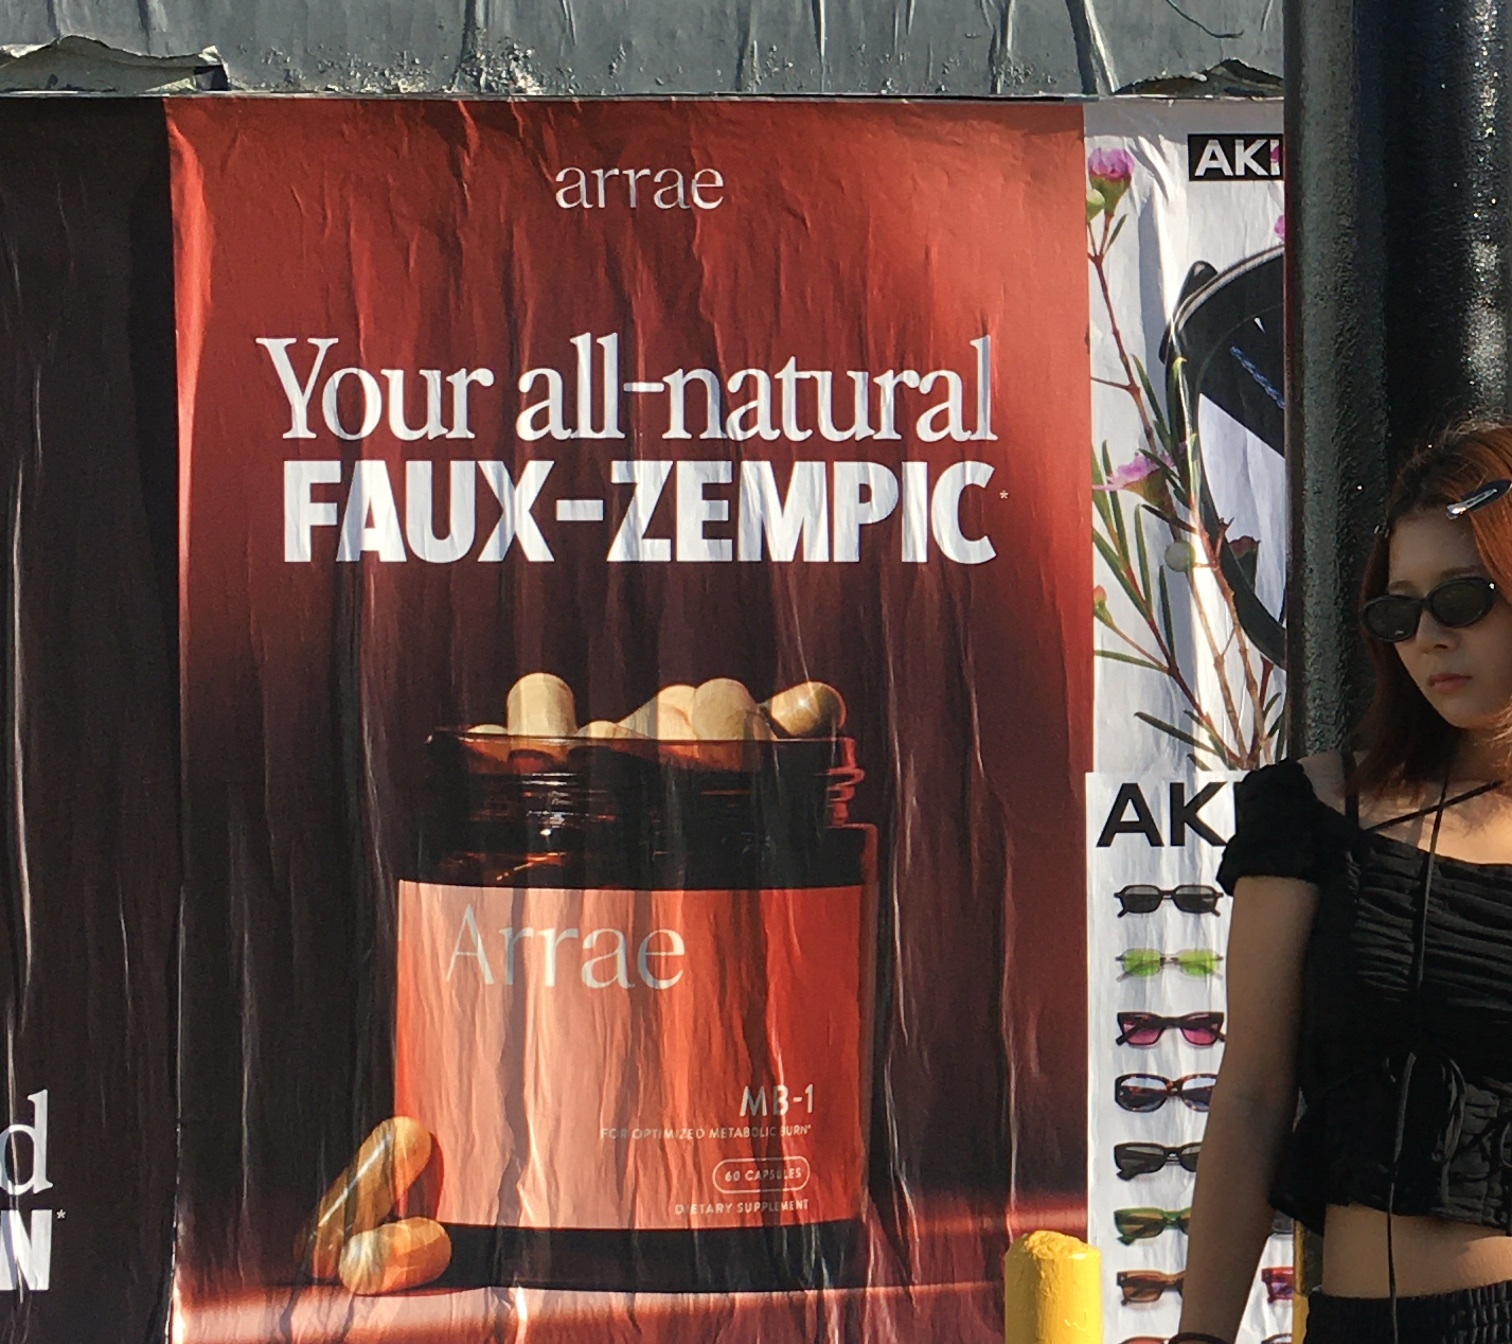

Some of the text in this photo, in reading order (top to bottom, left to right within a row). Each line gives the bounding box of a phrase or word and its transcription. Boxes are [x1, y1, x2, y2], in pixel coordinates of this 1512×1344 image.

[555, 166, 724, 210] arrae
[256, 333, 998, 442] Your all-natural
[1096, 782, 1241, 847] AK
[446, 903, 685, 989] Arrae
[740, 1083, 814, 1117] MB-1
[601, 1127, 628, 1140] FOR
[631, 1127, 706, 1140] OPTIMIZED
[708, 1126, 778, 1139] METABOLIC
[724, 1167, 802, 1183] 60 CAPSULES
[736, 1199, 809, 1214] SUPPLEMENT
